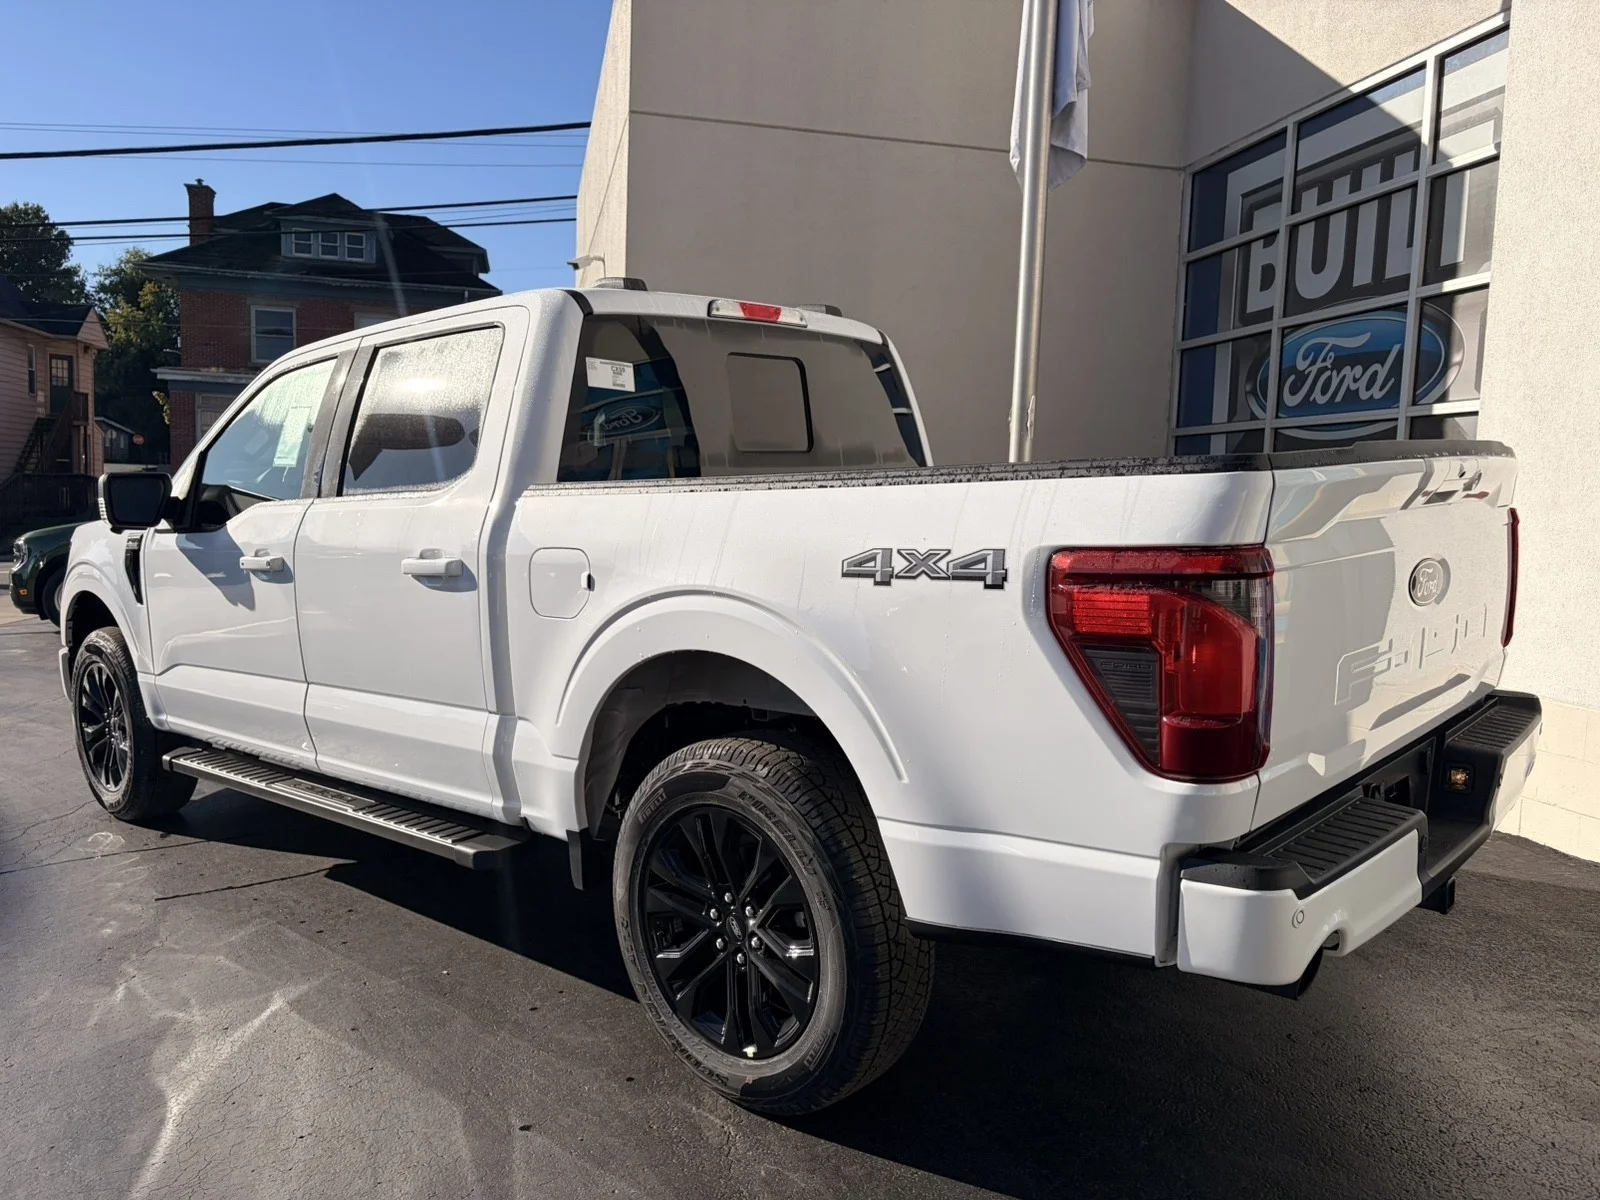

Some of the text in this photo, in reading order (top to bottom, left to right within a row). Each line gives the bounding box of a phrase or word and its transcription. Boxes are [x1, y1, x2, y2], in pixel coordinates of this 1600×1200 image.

[1245, 116, 1497, 316] BUILT
[1282, 330, 1404, 407] Ford
[1417, 567, 1440, 597] Ford
[637, 787, 668, 824] PIRELLI
